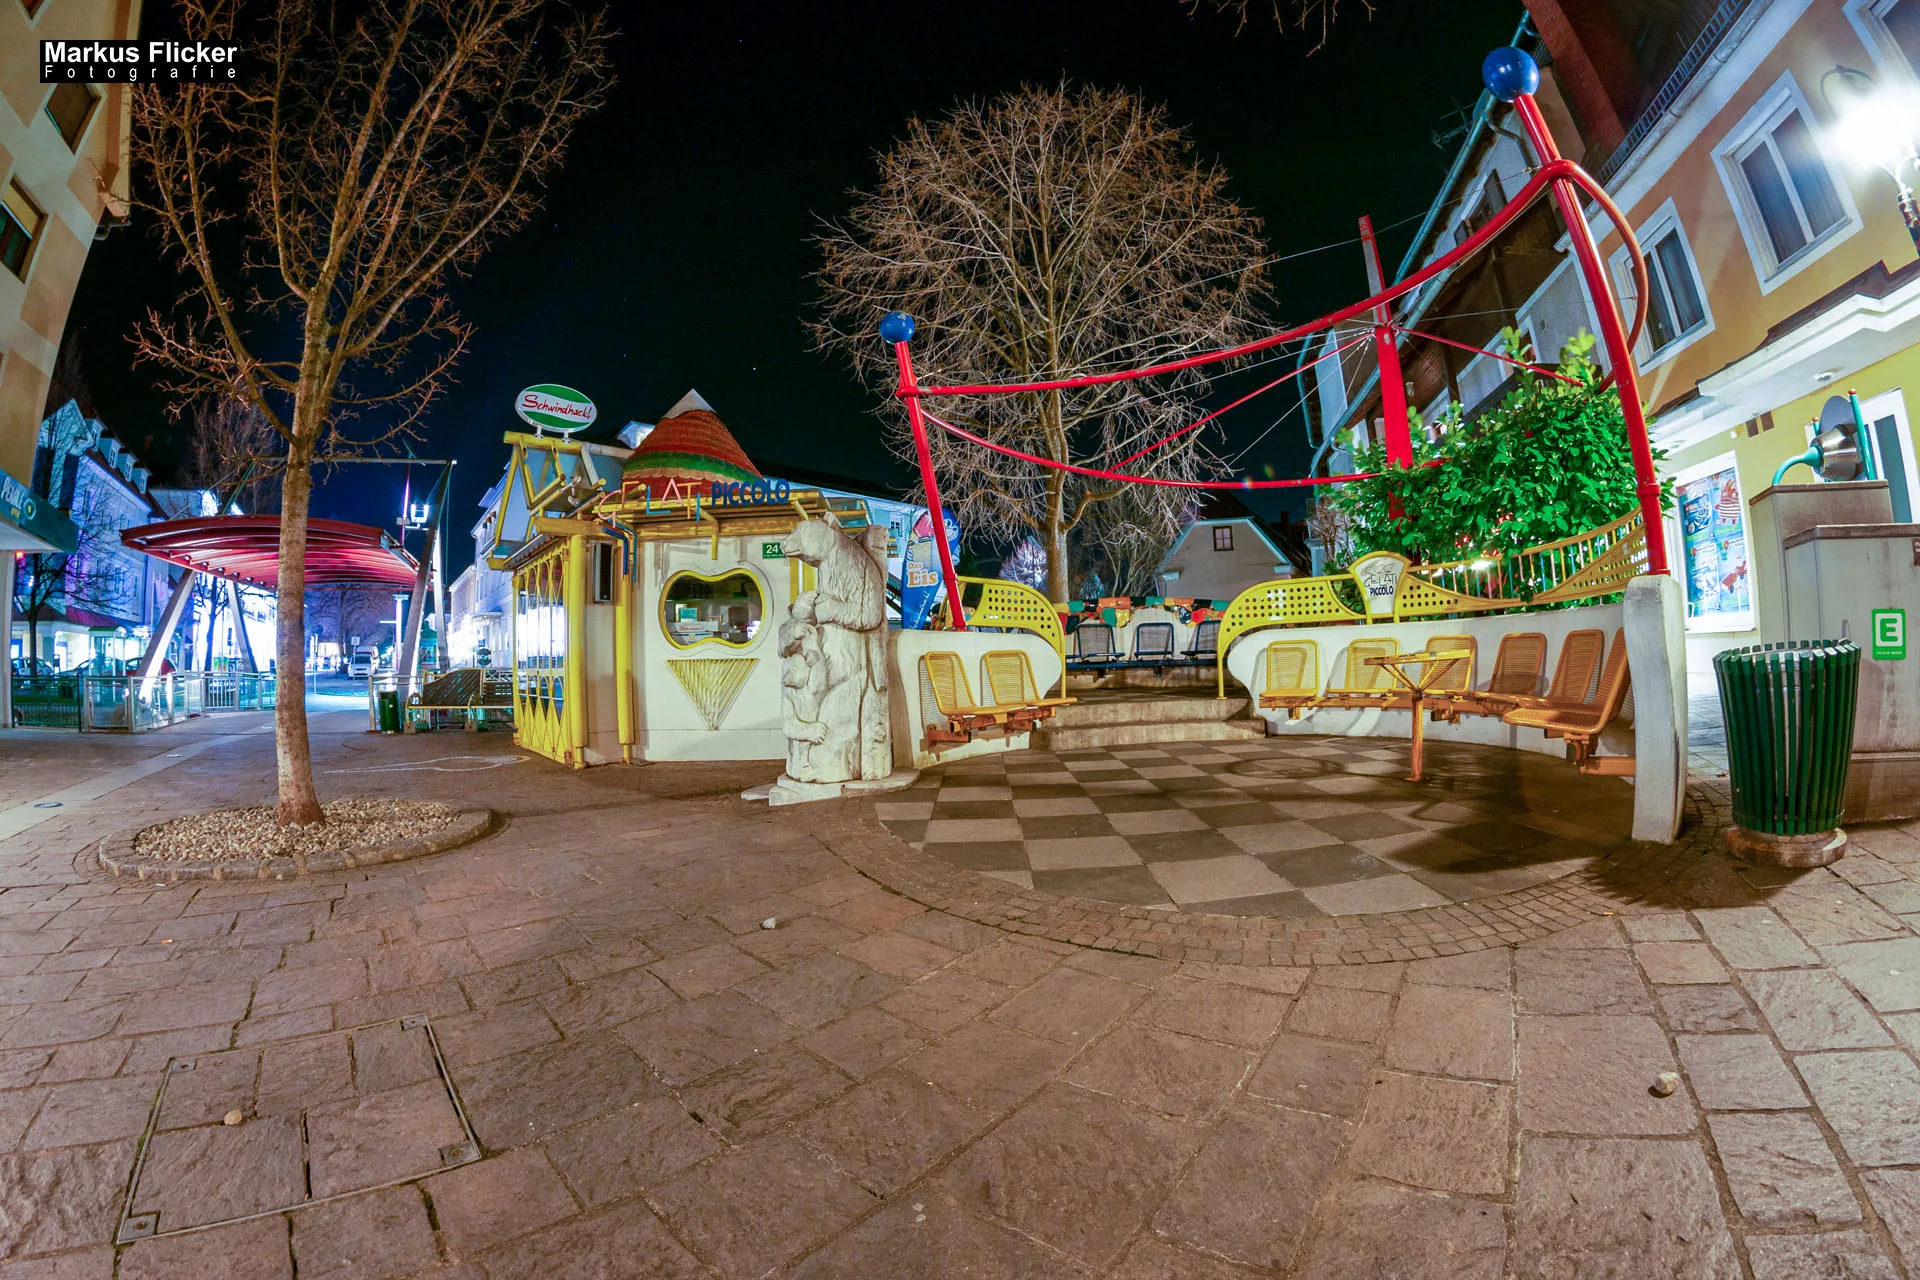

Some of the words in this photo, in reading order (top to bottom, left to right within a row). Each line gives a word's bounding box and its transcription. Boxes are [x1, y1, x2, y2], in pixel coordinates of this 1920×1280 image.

[521, 394, 593, 419] Schwindhackl
[711, 478, 790, 508] PICCOLO
[907, 562, 924, 570] Das
[907, 570, 938, 588] Eis
[1364, 573, 1398, 588] GELATI
[1370, 585, 1394, 597] PICCOLO
[1880, 618, 1899, 642] E
